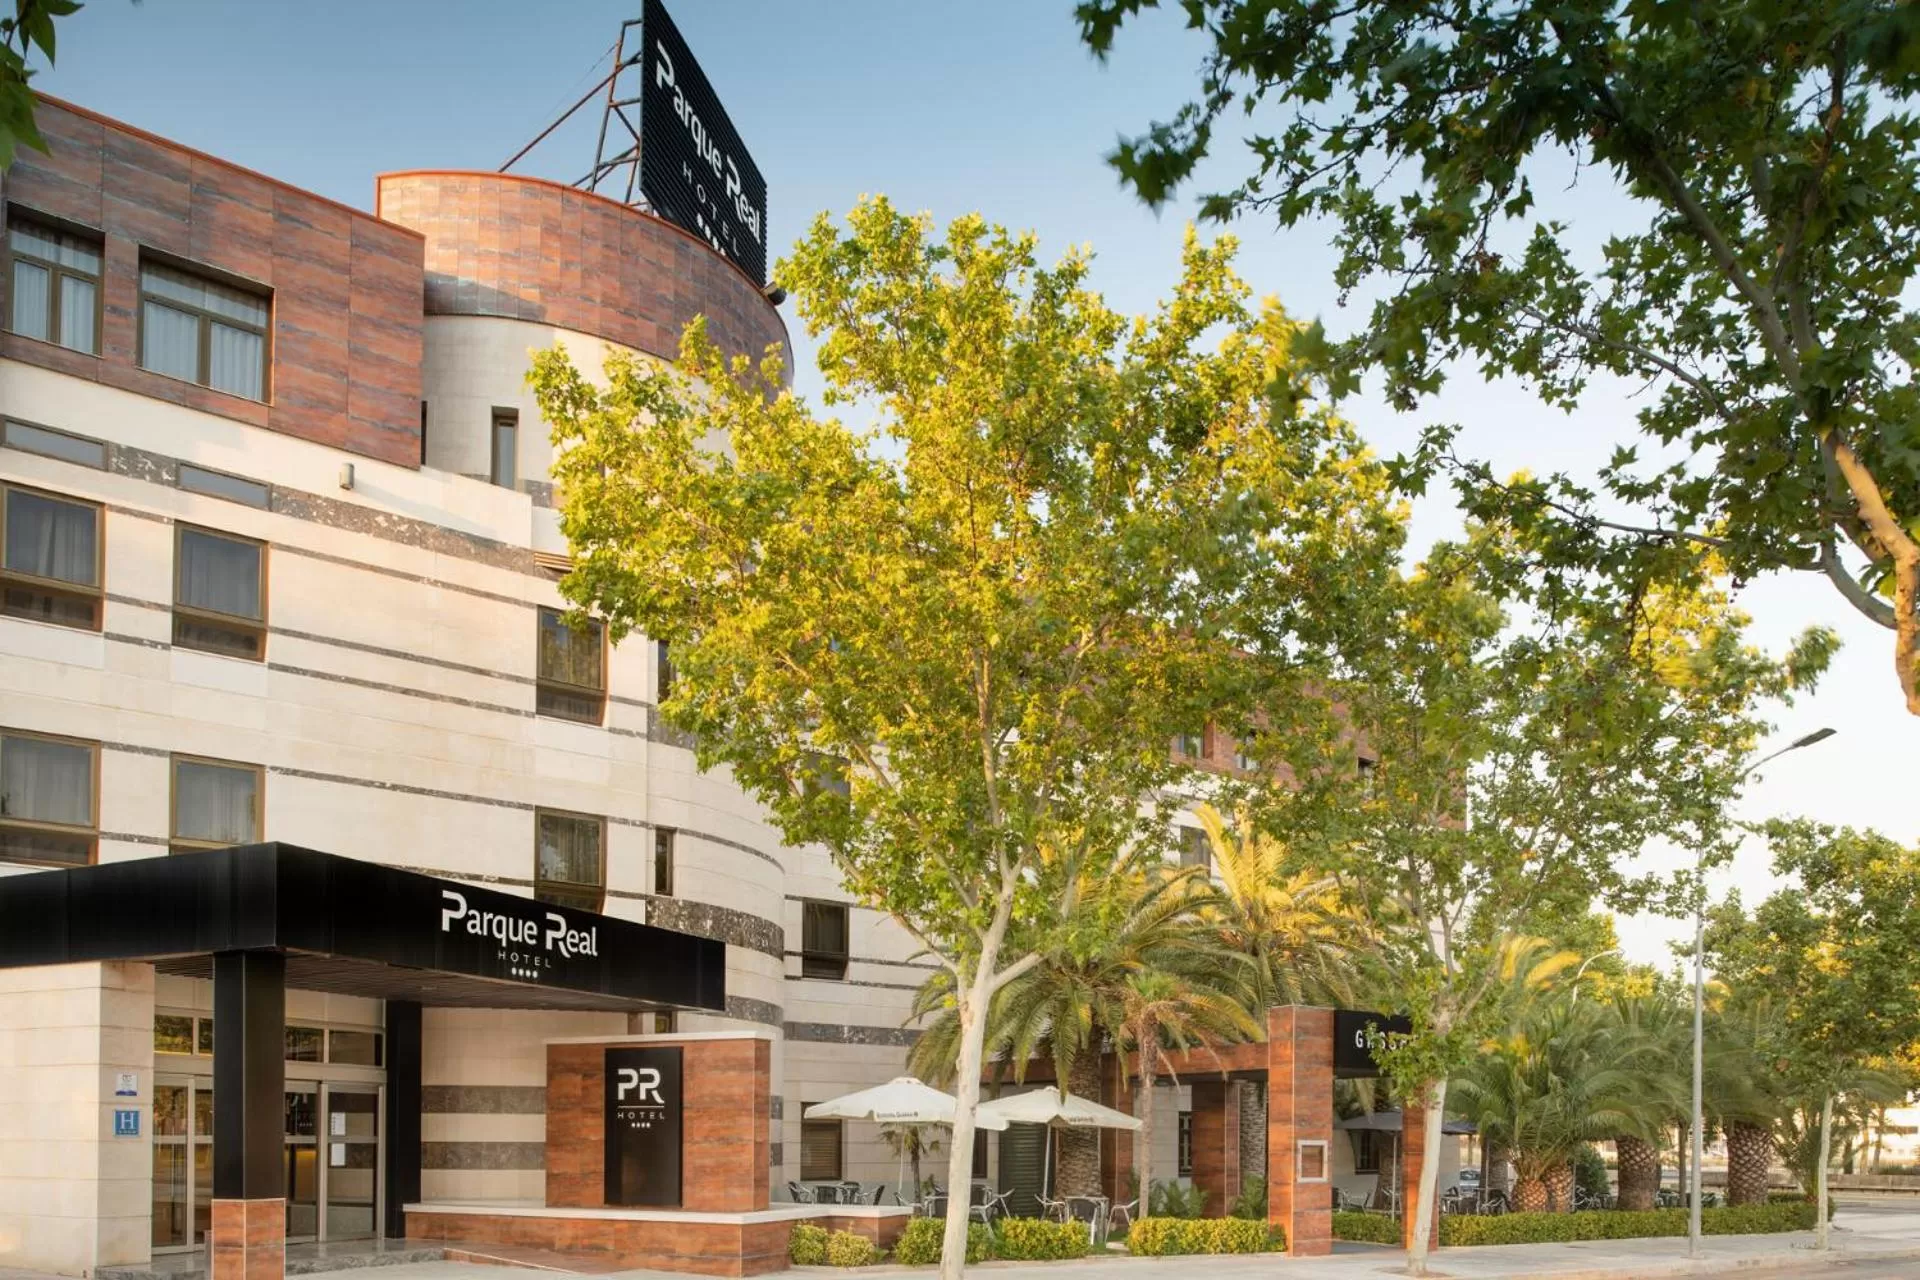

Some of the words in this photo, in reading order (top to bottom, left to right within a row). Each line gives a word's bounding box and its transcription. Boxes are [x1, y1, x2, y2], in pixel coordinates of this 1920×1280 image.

[656, 40, 724, 179] Parque
[726, 155, 762, 244] Real
[682, 160, 741, 258] HOTEL
[441, 889, 539, 948] Parque
[545, 911, 599, 959] Real
[497, 950, 552, 969] HOTEL
[617, 1067, 666, 1105] PR
[120, 1111, 135, 1130] H
[617, 1111, 666, 1120] HOTEL
